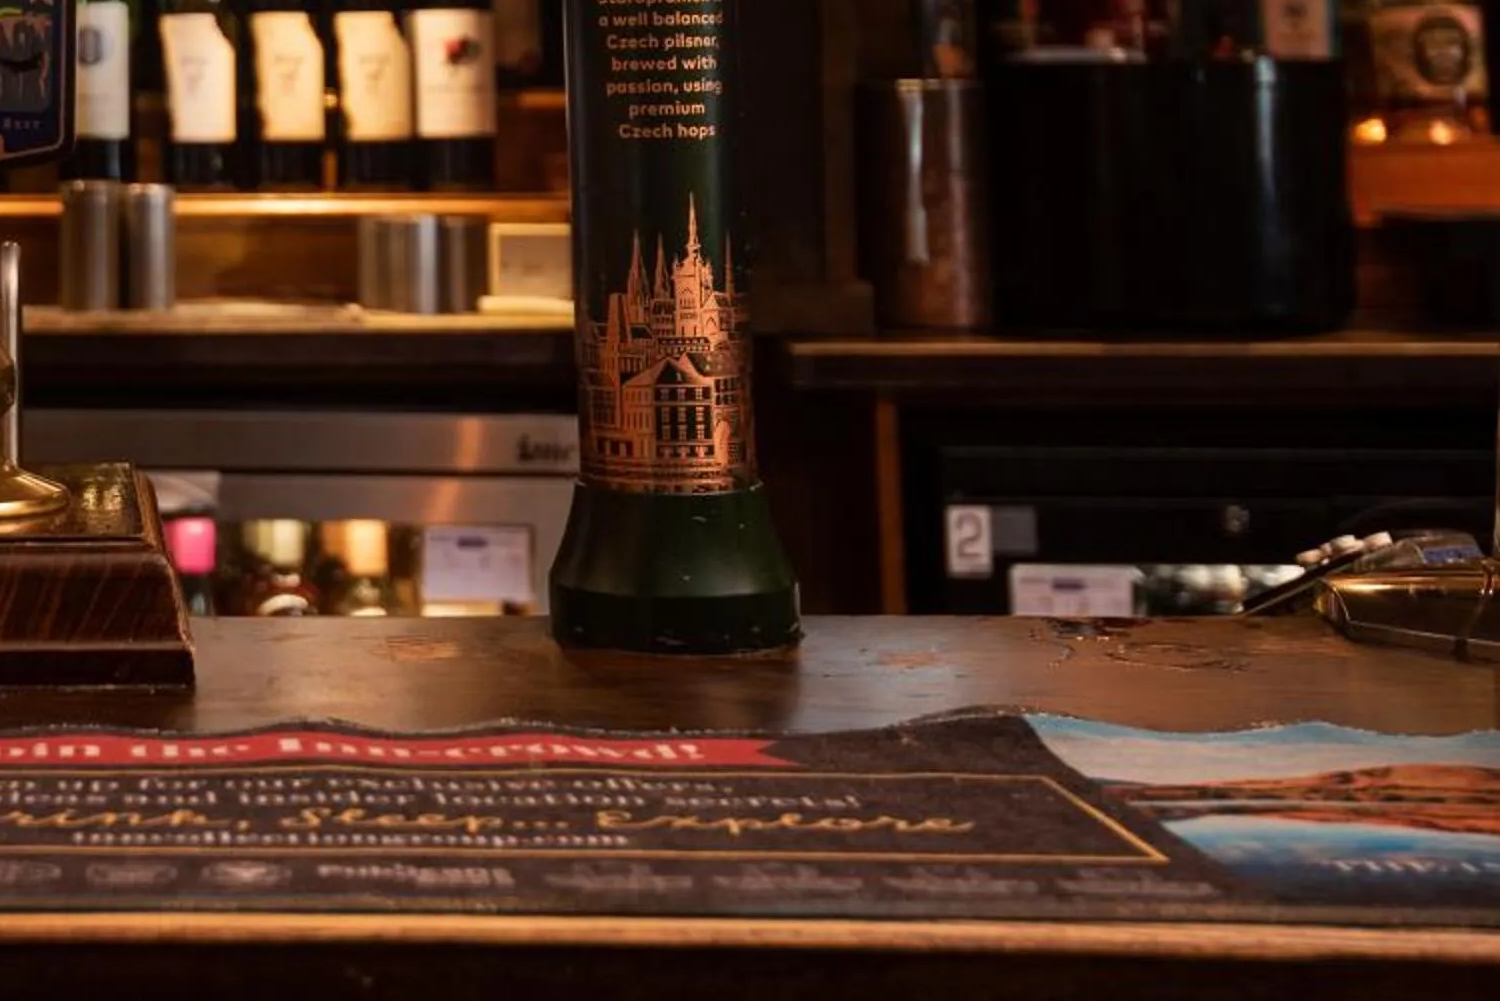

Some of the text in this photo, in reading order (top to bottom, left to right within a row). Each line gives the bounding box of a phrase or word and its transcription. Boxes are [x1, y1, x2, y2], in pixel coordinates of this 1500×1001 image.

[598, 10, 724, 27] a well balanced
[606, 34, 660, 50] Czech
[611, 54, 718, 72] brewed with
[606, 78, 723, 98] passion, using
[628, 101, 706, 120] premium
[618, 122, 718, 141] Czech hops
[954, 513, 983, 560] 2
